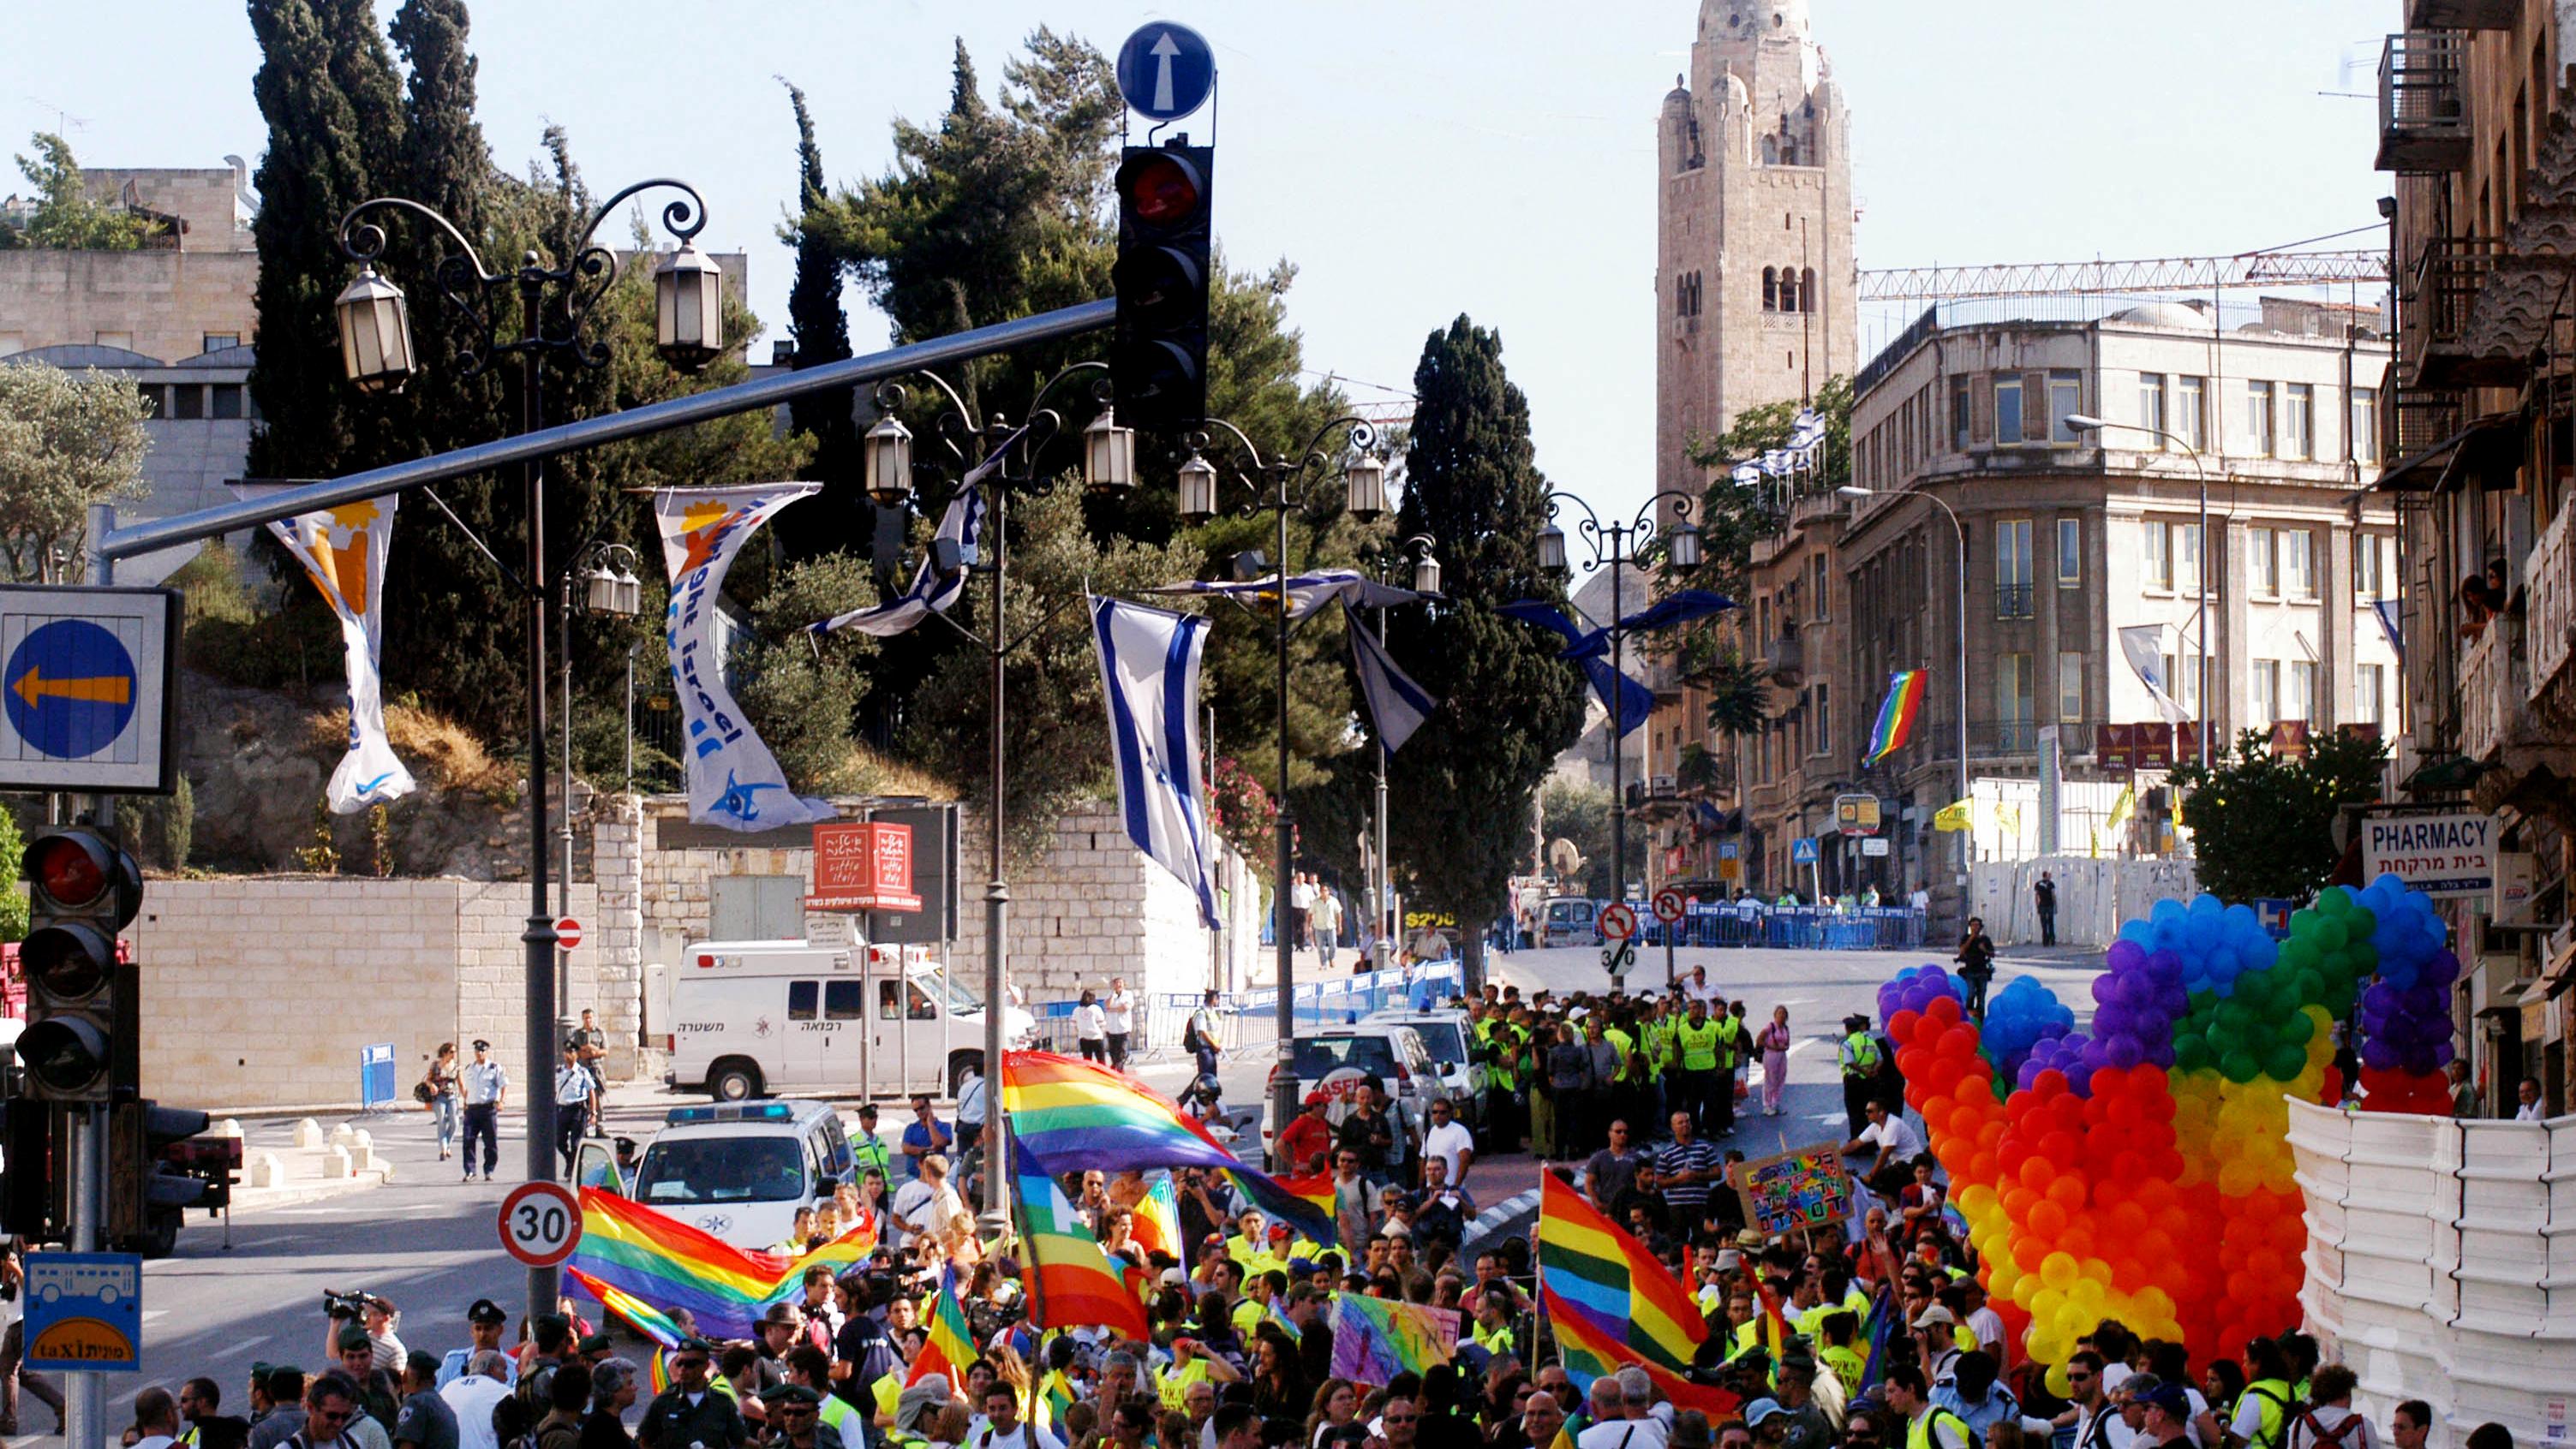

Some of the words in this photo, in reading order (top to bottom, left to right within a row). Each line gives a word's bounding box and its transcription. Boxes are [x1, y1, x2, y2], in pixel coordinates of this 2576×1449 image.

[682, 639, 744, 744] israel
[2372, 820, 2488, 853] PHARMACY
[2379, 857, 2446, 875] מרקחת
[2453, 855, 2487, 869] בית
[677, 1022, 725, 1032] משטרה
[801, 1022, 842, 1032] רפואה
[516, 1204, 565, 1244] 30
[39, 1339, 83, 1358] taxi
[86, 1344, 124, 1358] מונית
